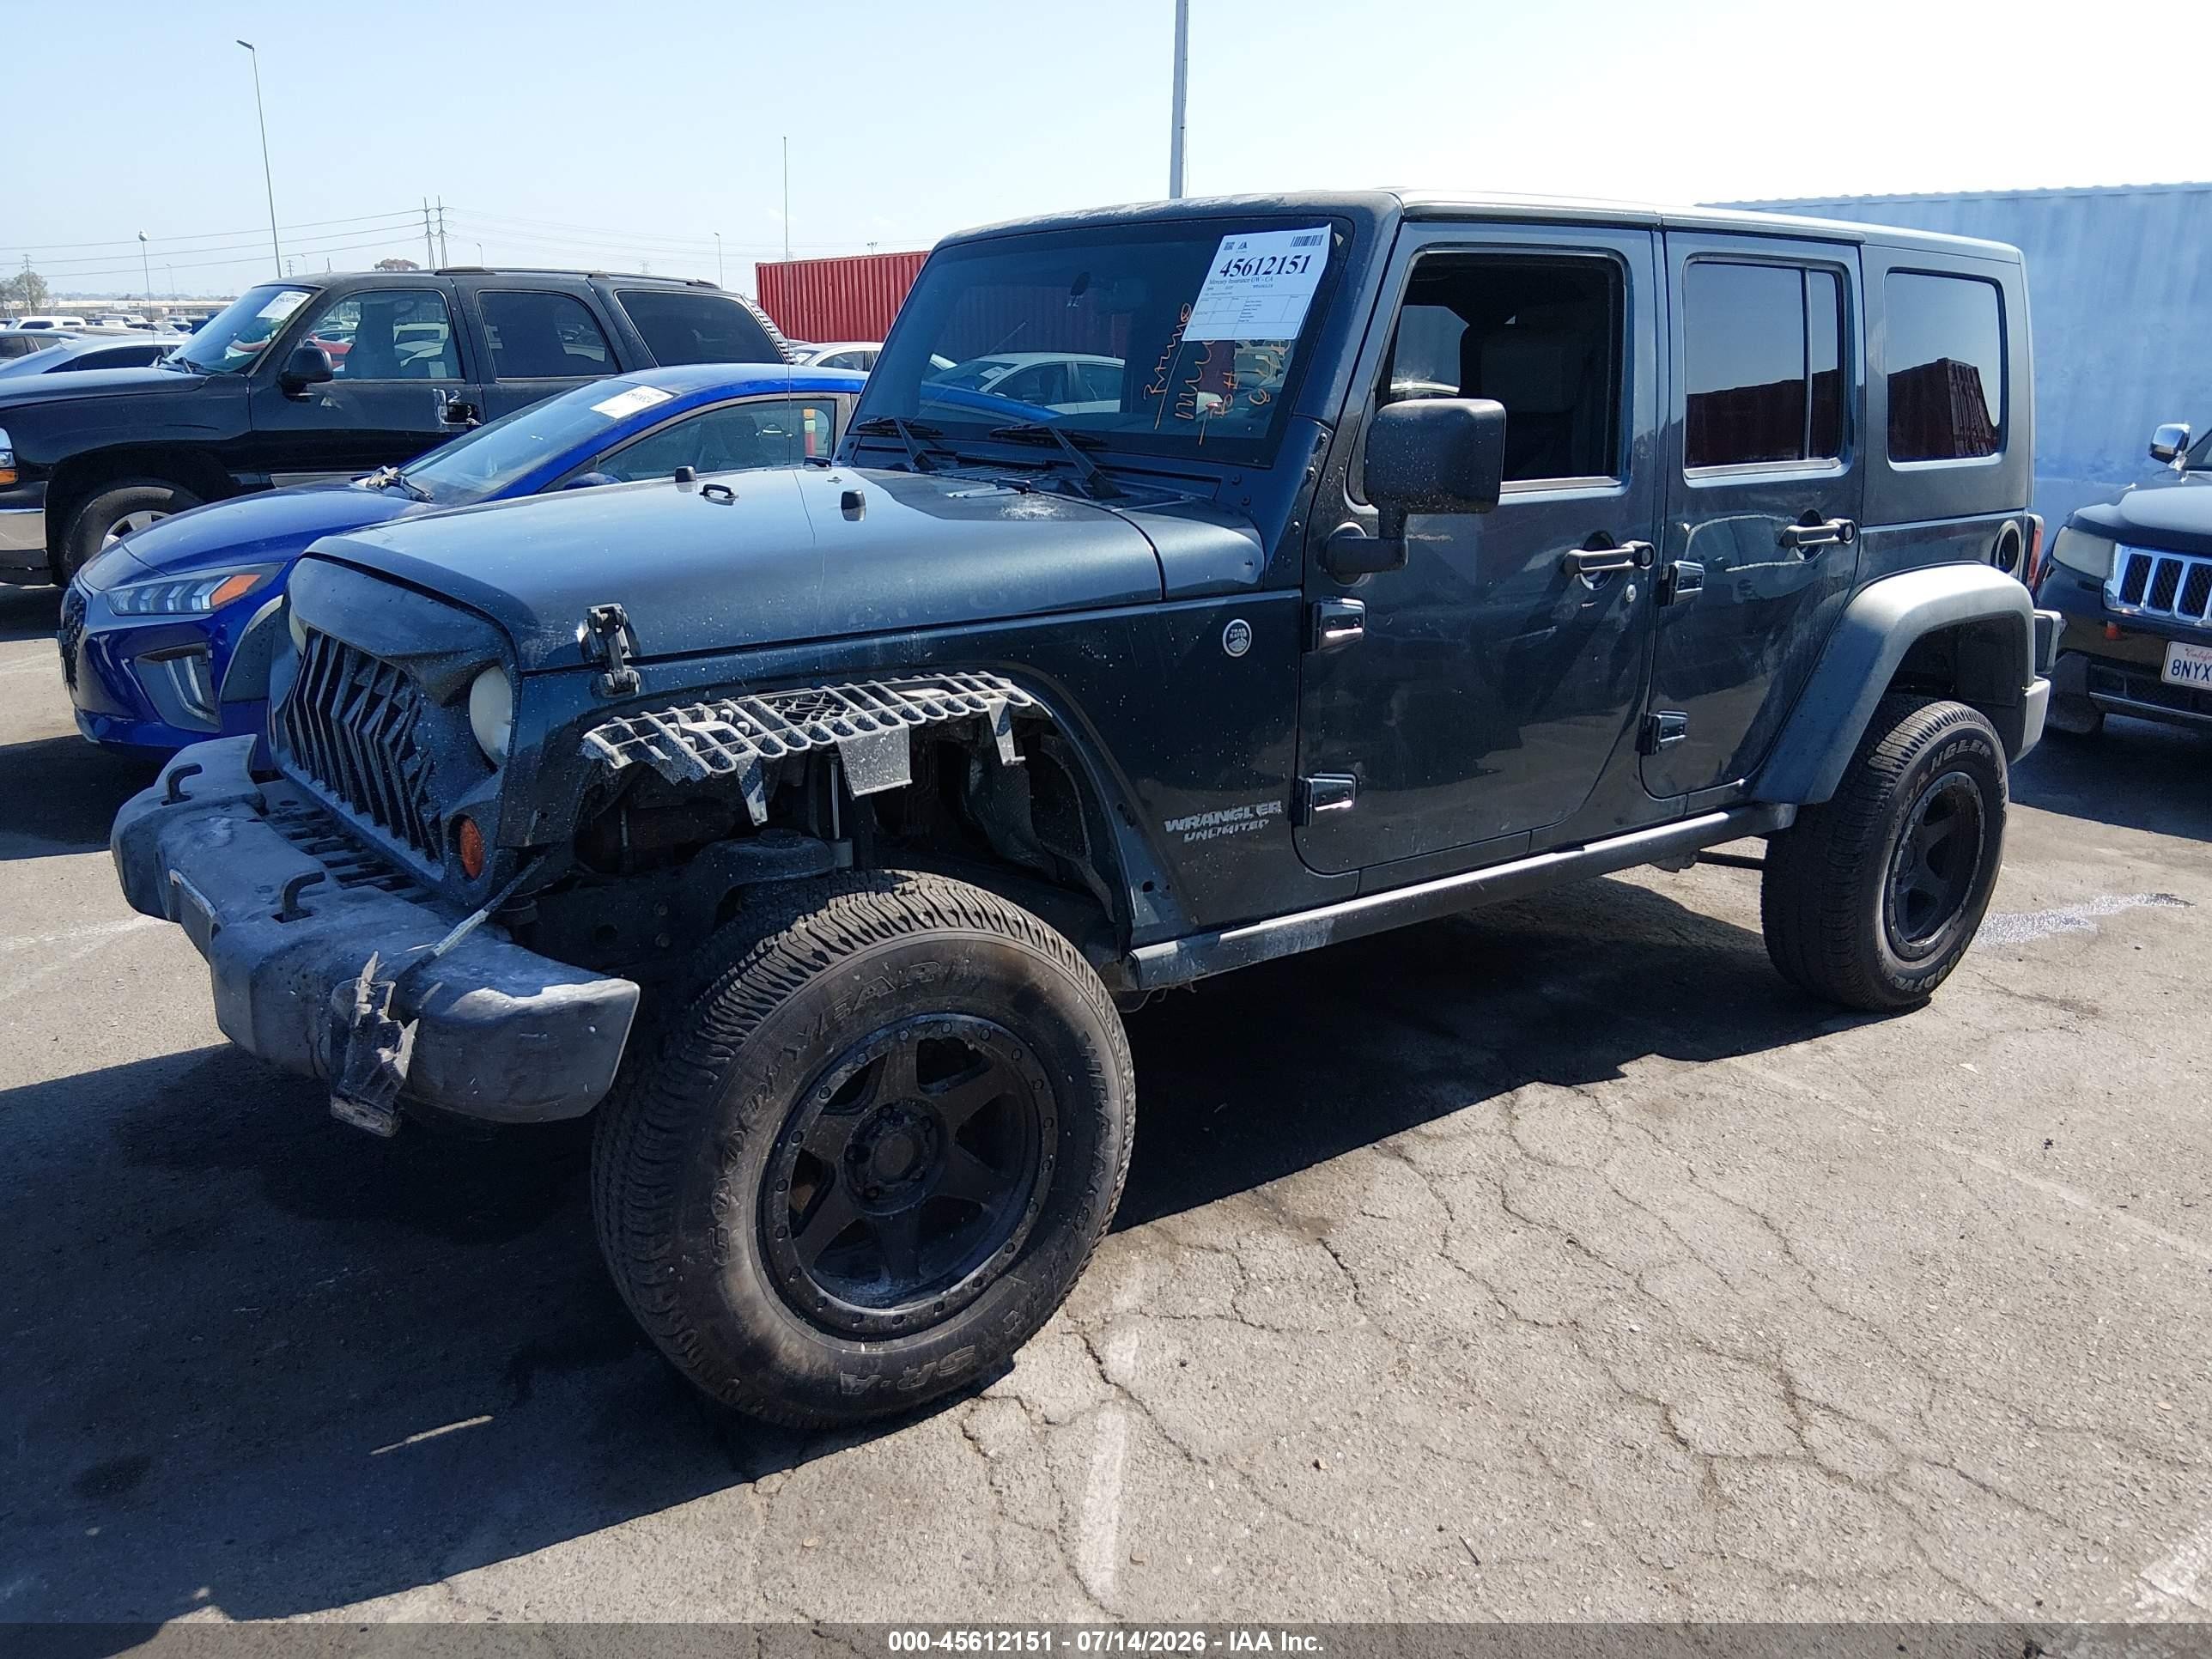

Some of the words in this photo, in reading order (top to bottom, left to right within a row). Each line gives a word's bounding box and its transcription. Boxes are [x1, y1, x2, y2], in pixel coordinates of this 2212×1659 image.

[1219, 254, 1312, 277] 45612151
[2172, 659, 2212, 682] 8NYX
[1164, 800, 1282, 833] WRANGLER
[1183, 818, 1270, 842] UNLIMITED
